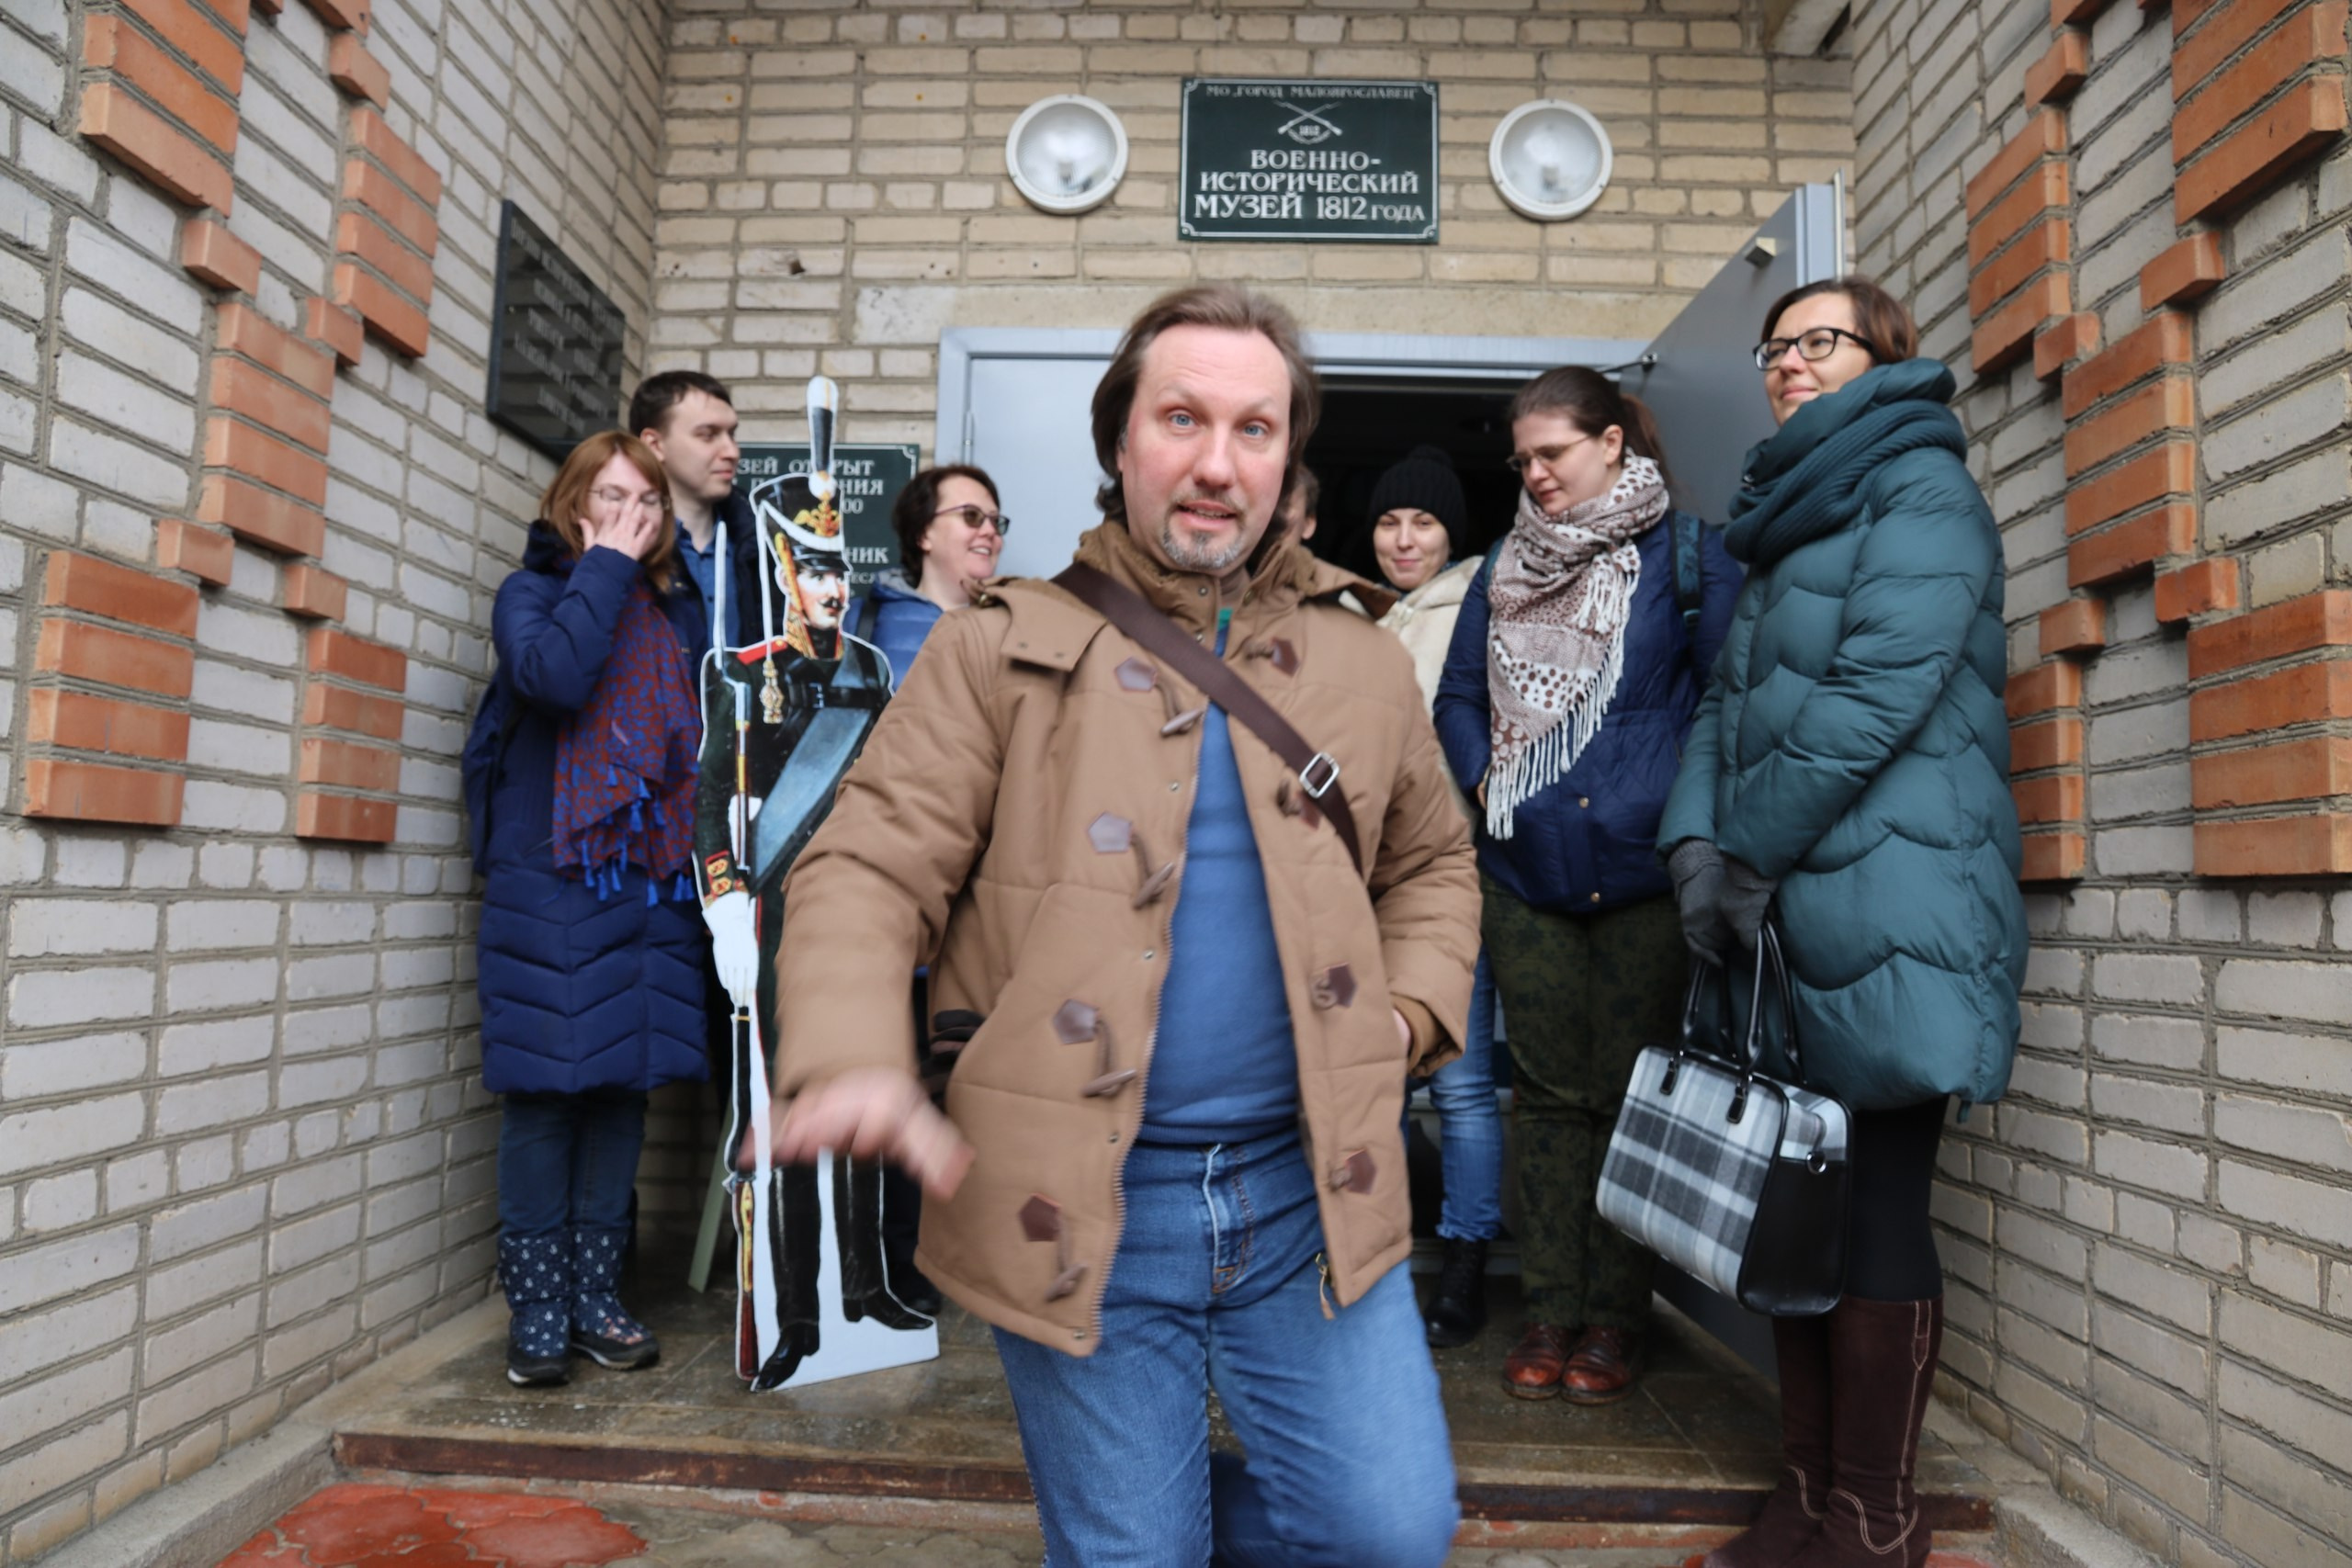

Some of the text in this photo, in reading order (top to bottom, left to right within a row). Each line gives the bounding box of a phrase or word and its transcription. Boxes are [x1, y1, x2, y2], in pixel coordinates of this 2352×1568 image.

[1206, 85, 1230, 96] МО
[1299, 125, 1320, 136] 1812
[1250, 149, 1382, 171] ВОЕННО-
[1200, 171, 1419, 194] ИСТОРИЧЕСКИЙ
[1194, 191, 1303, 219] МУЗЕЙ
[1317, 196, 1367, 220] 1812
[737, 457, 875, 477] ЗЕЙ ОТРЫТ
